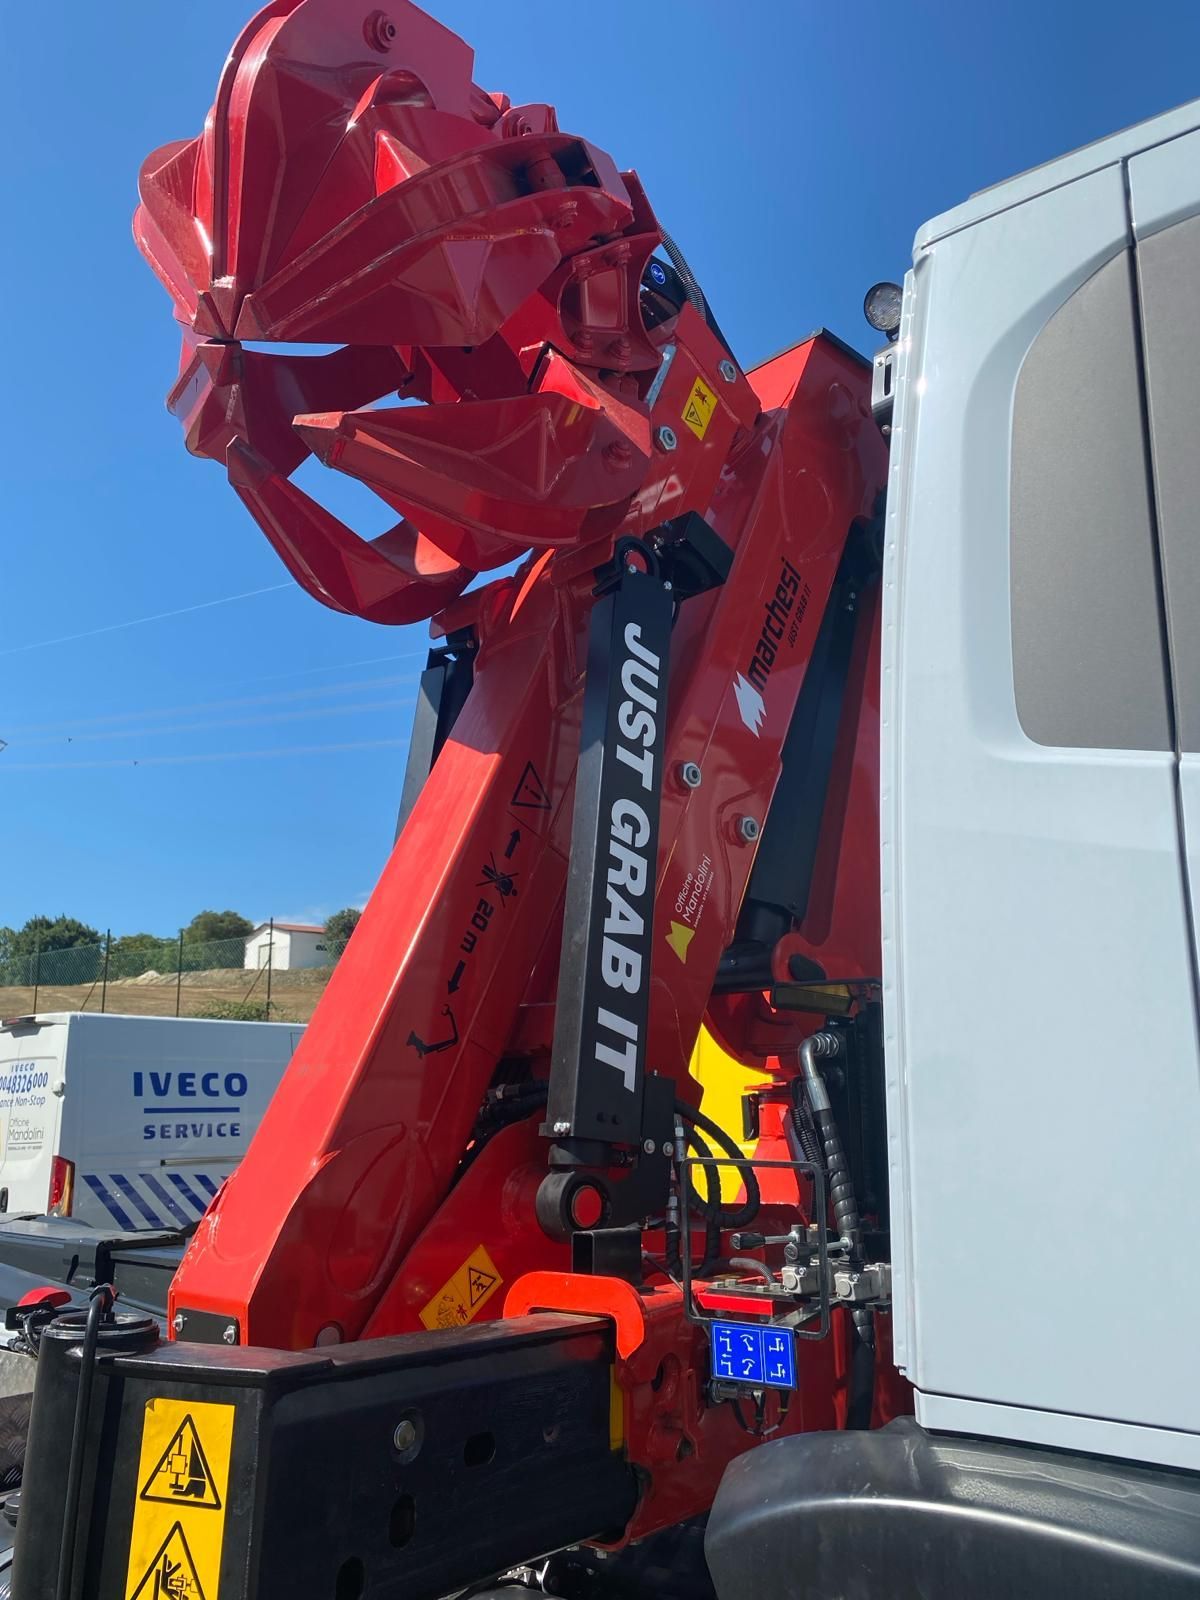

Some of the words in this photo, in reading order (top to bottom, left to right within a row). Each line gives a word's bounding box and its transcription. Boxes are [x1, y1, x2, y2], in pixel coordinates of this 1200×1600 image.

[748, 556, 802, 692] marchesi
[787, 619, 800, 649] JUST
[795, 594, 808, 624] GRAB
[803, 583, 812, 598] IT
[616, 622, 660, 792] JUST
[601, 798, 650, 994] GRAB
[675, 872, 694, 913] Officine
[682, 853, 712, 923] Mandolini
[471, 898, 495, 932] 20
[460, 930, 478, 954] m
[11, 1062, 35, 1072] IVECO
[595, 1006, 639, 1093] IT
[15, 1095, 46, 1108] Non-Stop
[133, 1072, 248, 1097] IVECO
[8, 1127, 45, 1141] Mandolini
[143, 1122, 241, 1140] SERVICE
